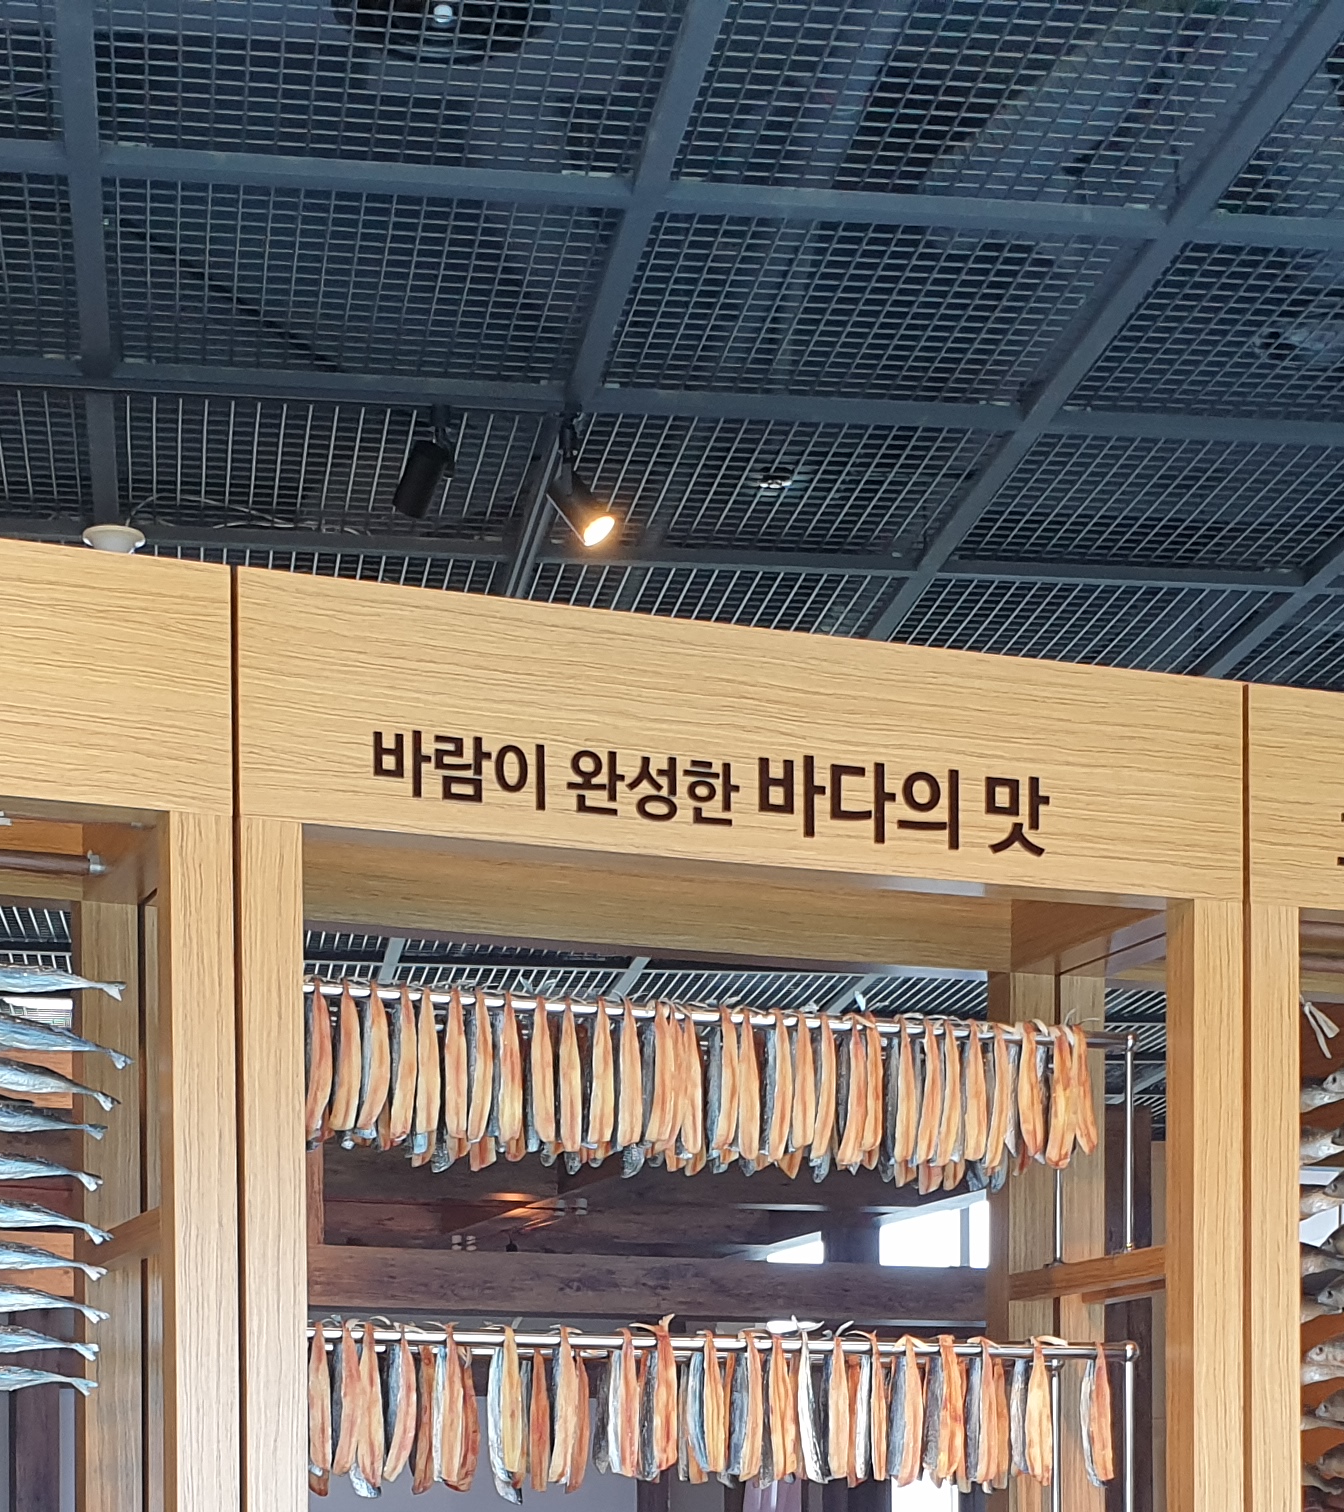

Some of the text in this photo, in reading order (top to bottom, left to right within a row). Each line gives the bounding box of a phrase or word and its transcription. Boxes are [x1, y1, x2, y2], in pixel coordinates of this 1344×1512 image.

[373, 730, 1049, 856] 바람이 완성한 바다의 맛
